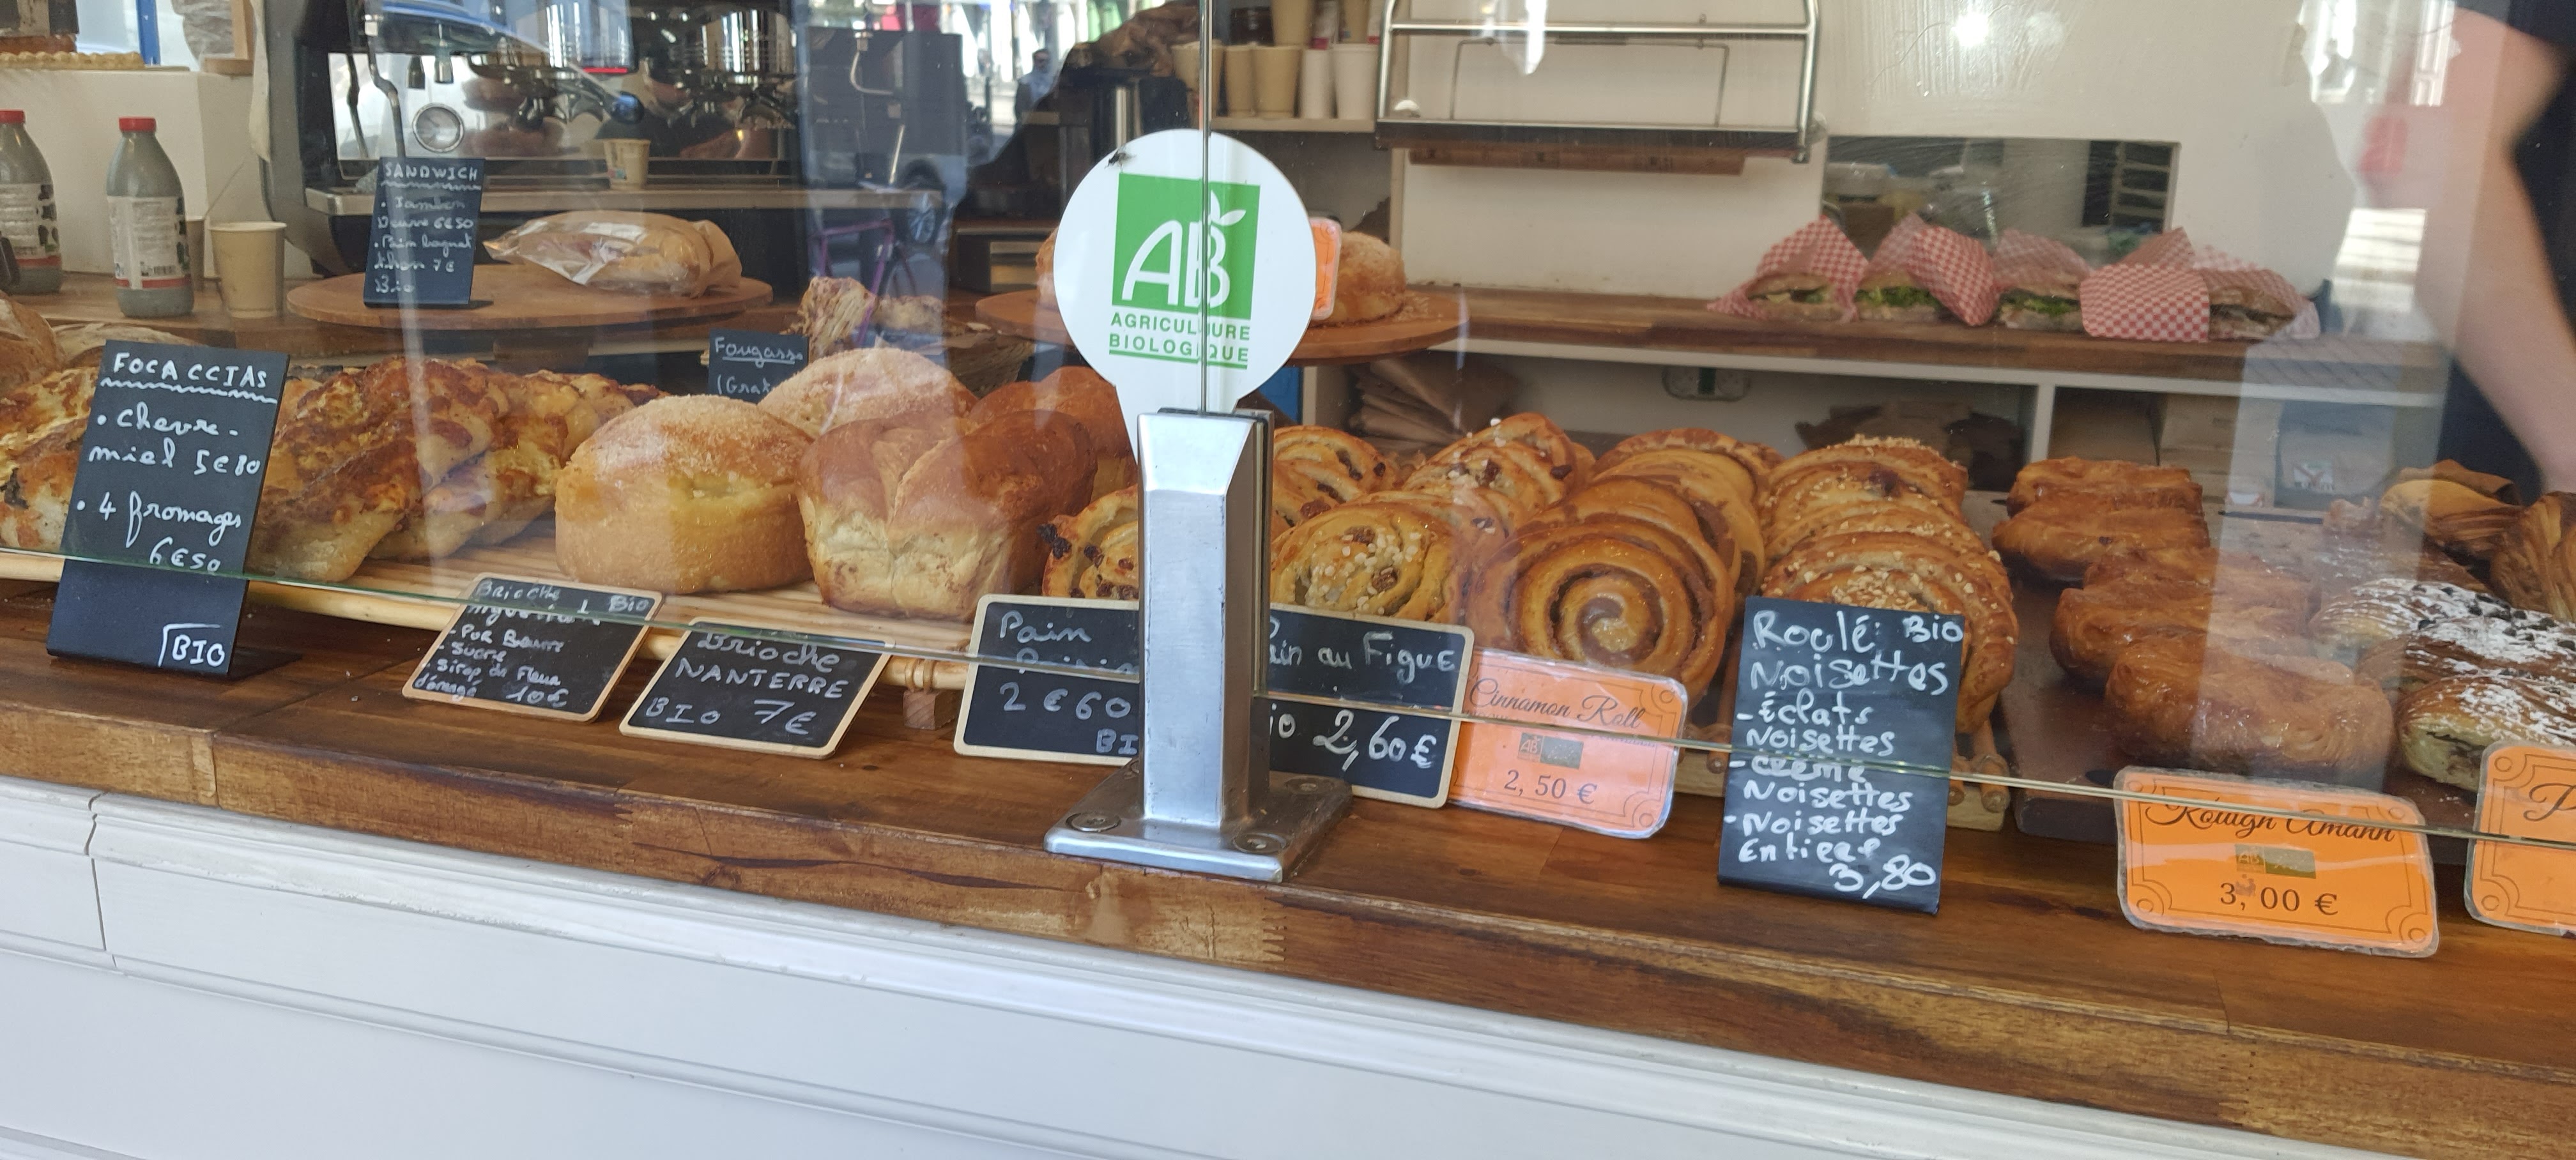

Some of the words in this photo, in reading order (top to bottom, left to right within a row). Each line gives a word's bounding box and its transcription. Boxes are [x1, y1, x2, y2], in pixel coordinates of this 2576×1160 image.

[385, 162, 477, 181] SANDWICH
[1121, 220, 1230, 309] AB
[1110, 312, 1250, 340] AGRICULURE
[88, 437, 176, 468] miel
[98, 491, 117, 521] 4
[125, 490, 241, 548] fromages
[999, 609, 1092, 644] Pain
[172, 634, 226, 668] BIO
[1318, 646, 1353, 670] au
[675, 657, 849, 699] NANTERRE
[1751, 650, 1949, 695] Noisettes
[754, 698, 817, 735] 7€
[1469, 678, 1572, 718] Cinnamon
[1577, 694, 1646, 729] Roll
[1096, 728, 1140, 755] BI
[1747, 724, 1896, 756] Noisettes
[1577, 782, 1598, 805] €
[1744, 779, 1914, 813] Noisettes
[1829, 853, 1936, 899] 3,80
[2314, 892, 2339, 915] €
